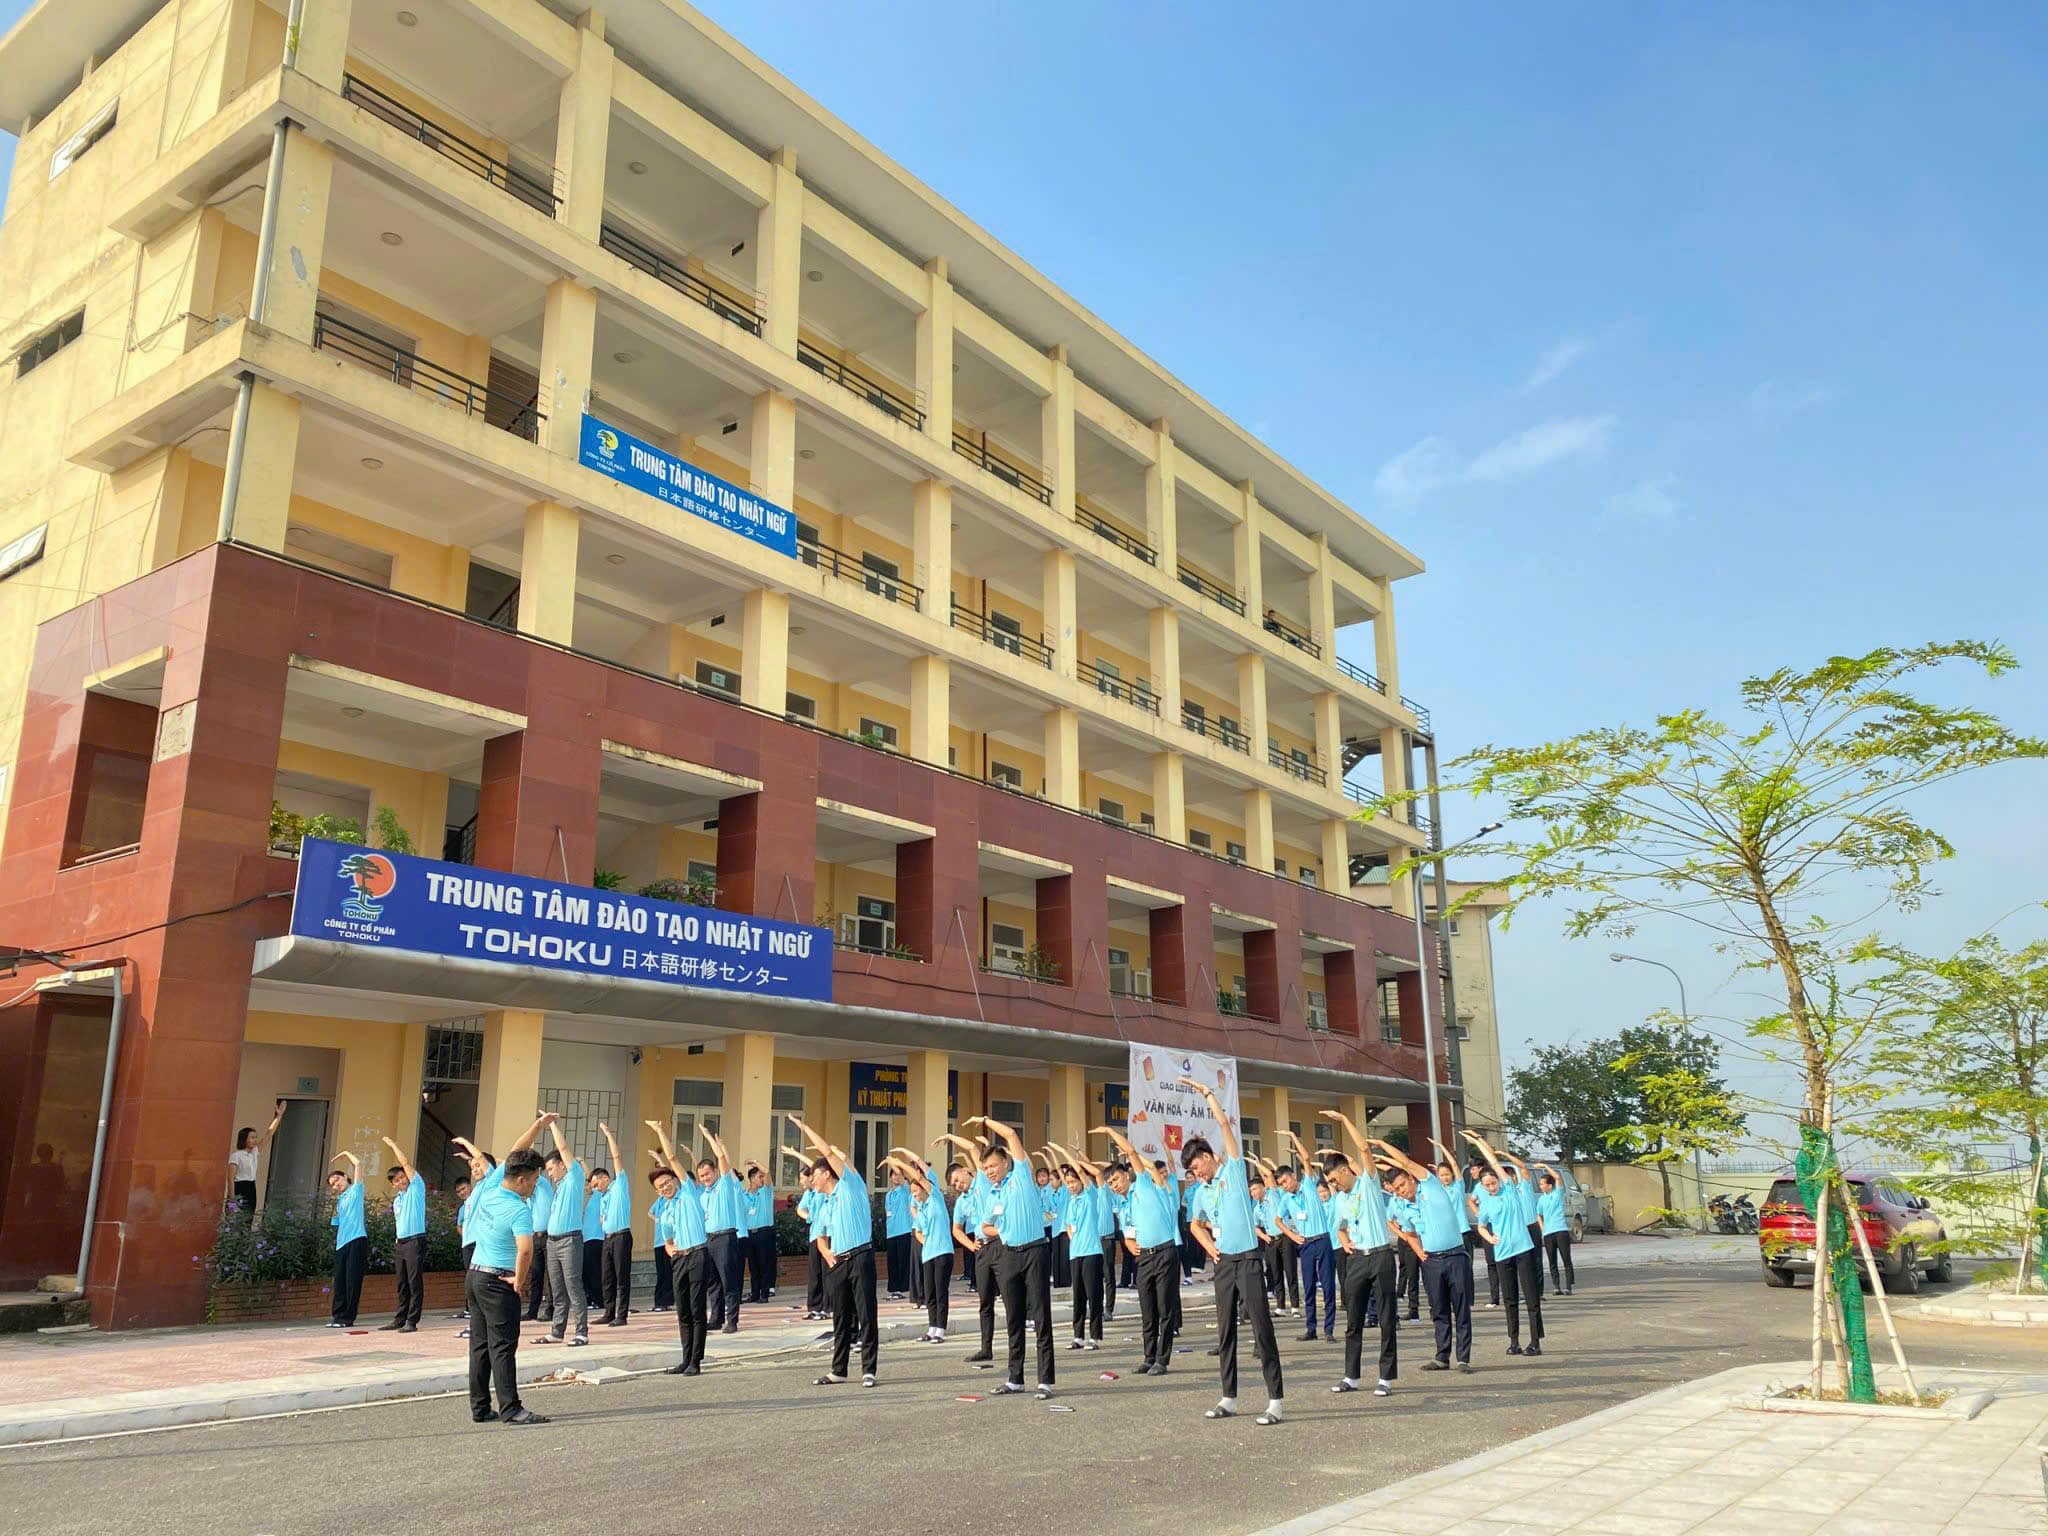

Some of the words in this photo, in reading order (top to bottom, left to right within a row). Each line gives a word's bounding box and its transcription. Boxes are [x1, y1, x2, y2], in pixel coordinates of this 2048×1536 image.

[629, 445, 667, 481] TRUNG
[668, 463, 692, 494] TÂM
[694, 475, 716, 502] ĐÀO
[717, 487, 737, 514] TẠO
[738, 496, 765, 530] NHẬT
[324, 918, 348, 930] CÔNG
[348, 922, 359, 931] TY
[344, 909, 378, 920] TOHOKU
[426, 872, 523, 916] TRUNG
[531, 889, 590, 926] TÂM
[597, 900, 648, 934] ĐÀO
[655, 911, 699, 945] TẠO
[706, 919, 763, 955] NHẬT
[768, 930, 814, 959] NGỮ
[338, 930, 380, 942] TOHOKU
[459, 923, 612, 967] TOHOKU
[622, 948, 789, 986] 日本語研修センター
